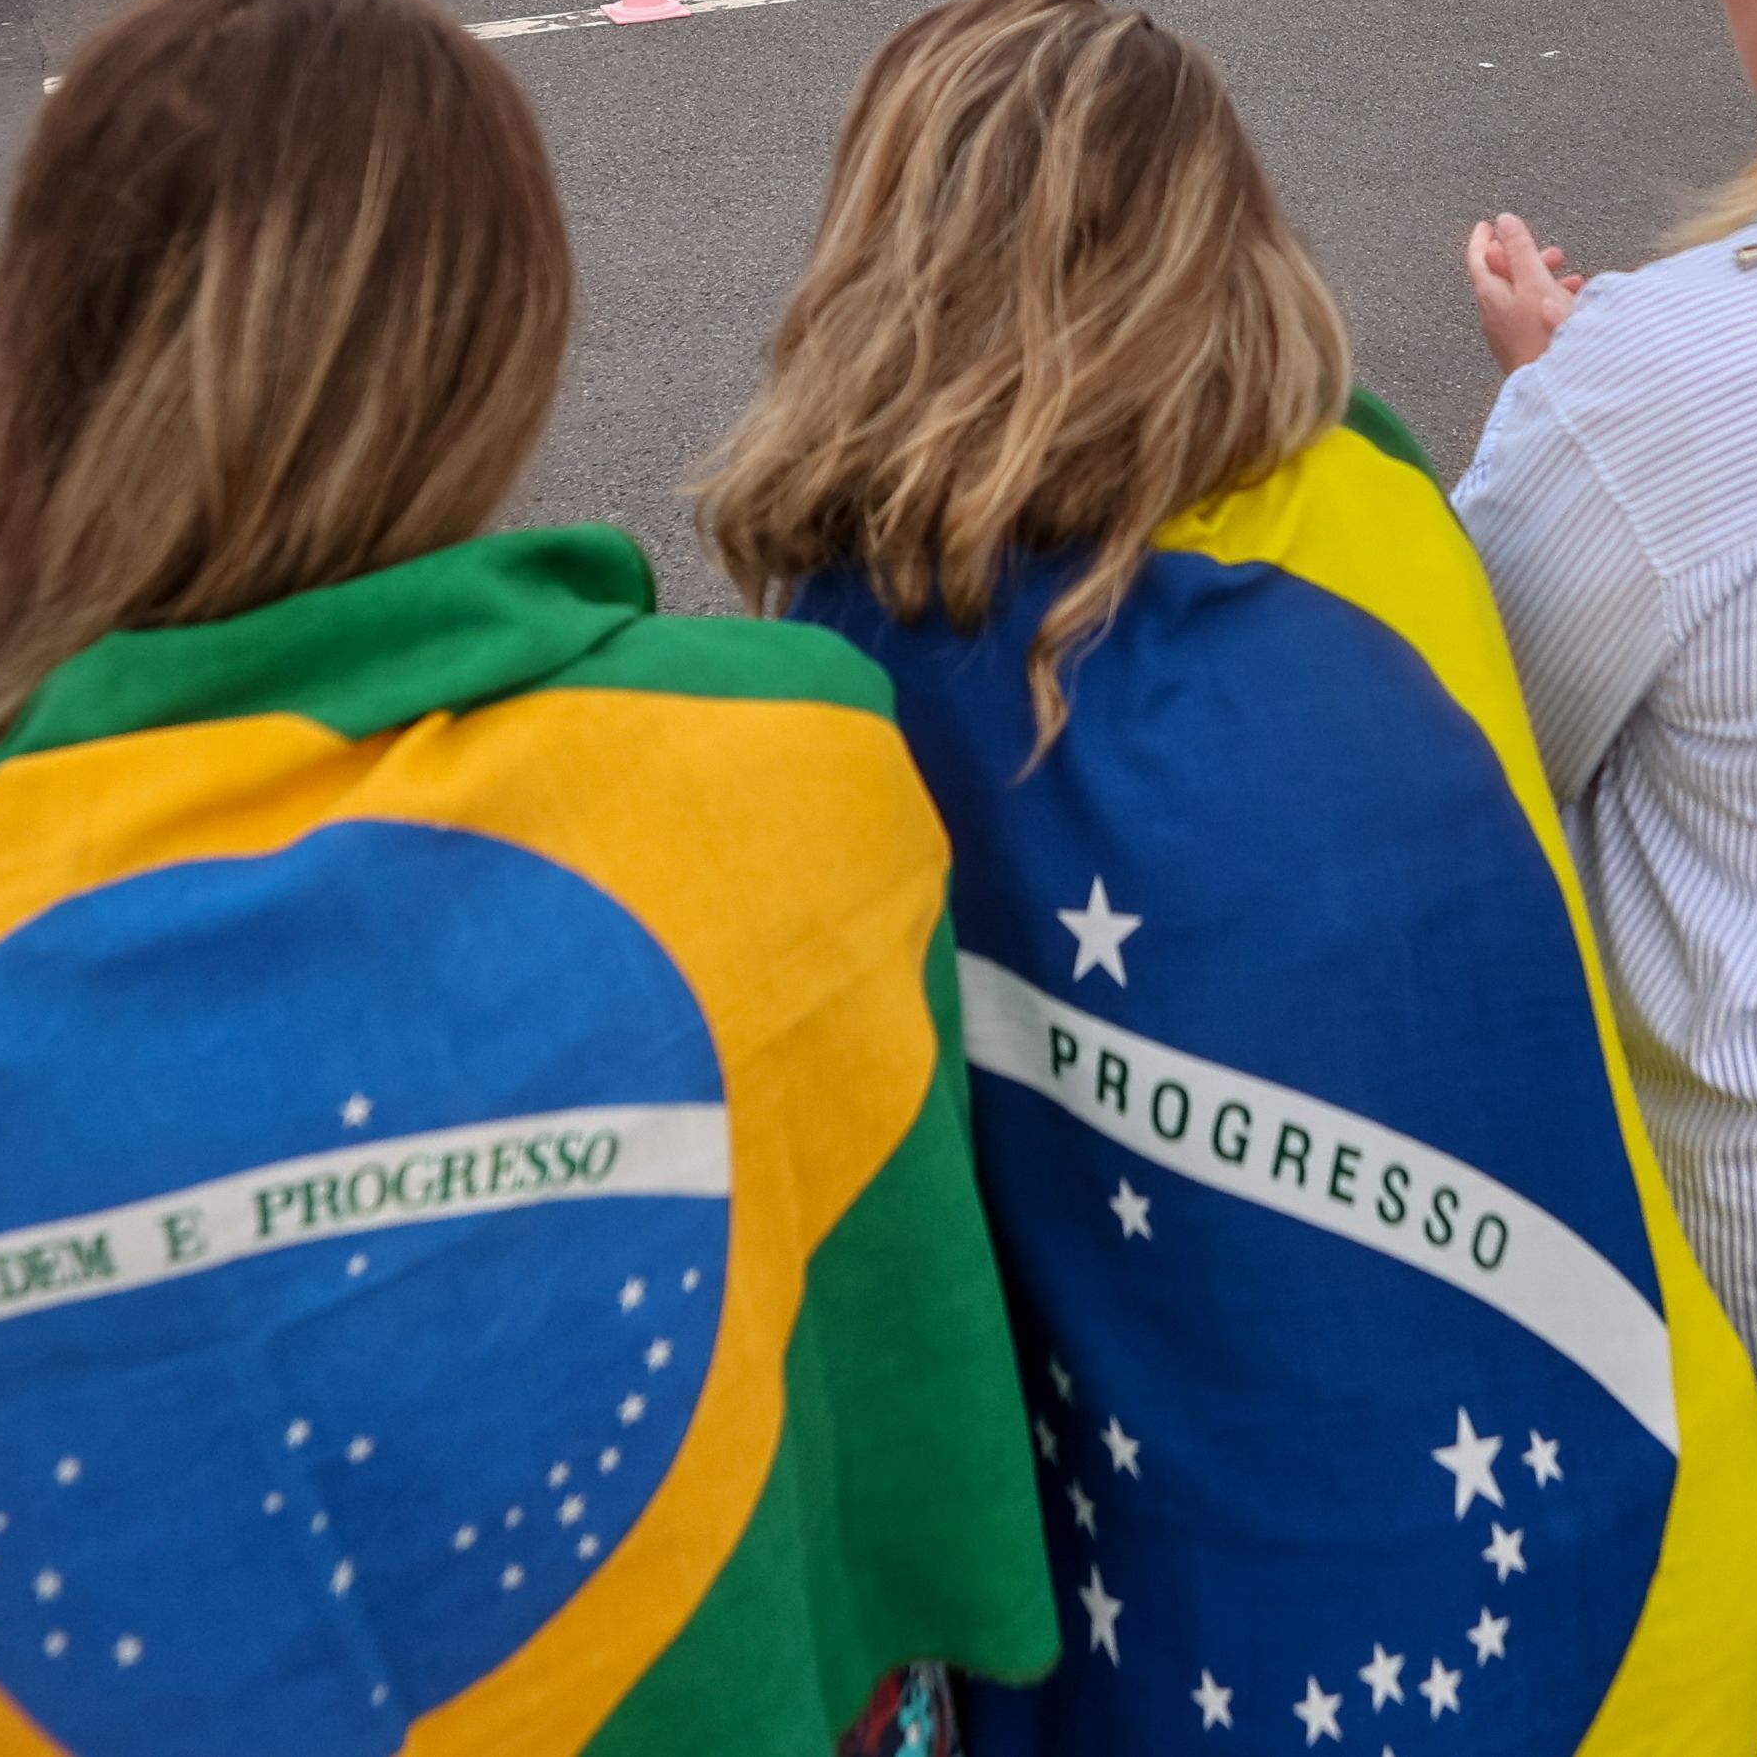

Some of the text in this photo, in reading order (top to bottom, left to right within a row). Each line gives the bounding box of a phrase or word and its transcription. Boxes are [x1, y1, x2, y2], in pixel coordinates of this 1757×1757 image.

[161, 1206, 208, 1264] E
[250, 1125, 622, 1241] PROGRESSO
[1047, 1023, 1513, 1274] PROGRESSO
